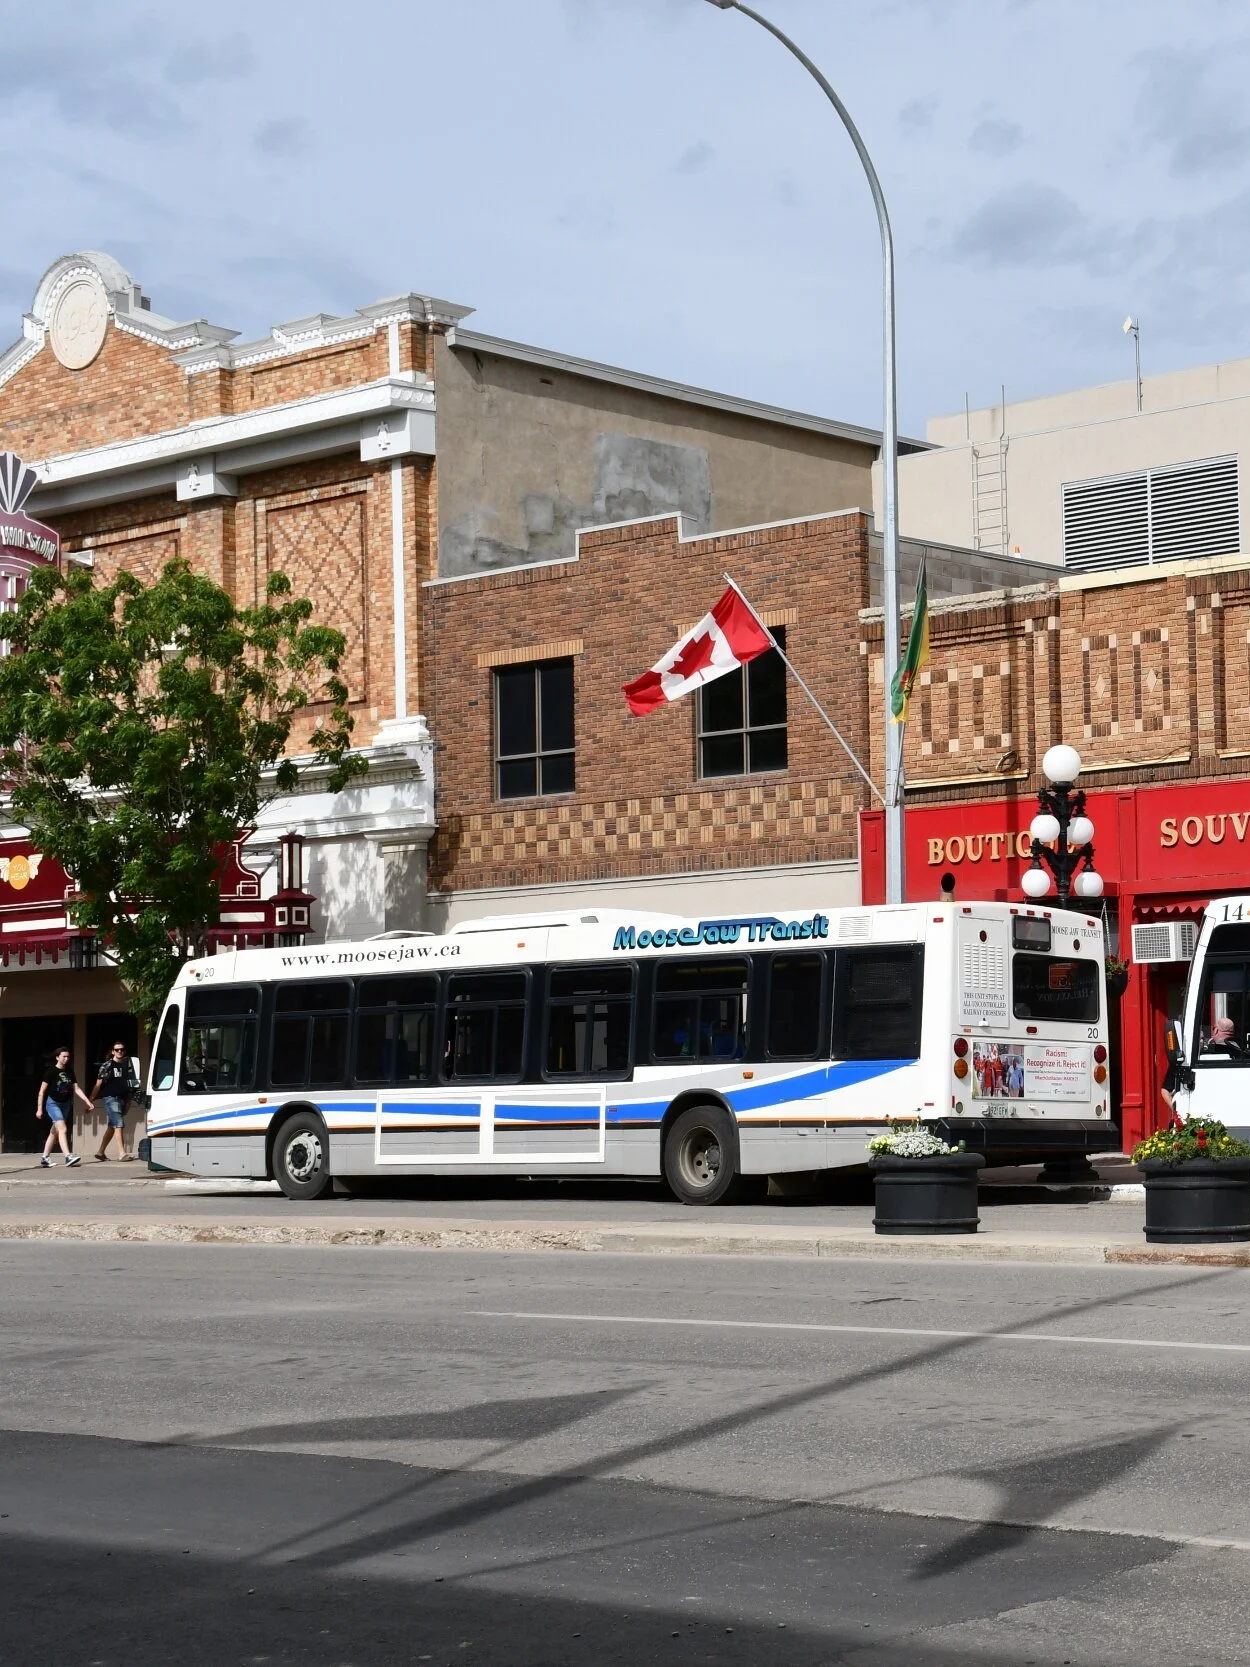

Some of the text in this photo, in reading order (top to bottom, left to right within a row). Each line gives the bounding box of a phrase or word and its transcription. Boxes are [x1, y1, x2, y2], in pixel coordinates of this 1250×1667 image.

[1222, 902, 1244, 922] 14
[1051, 925, 1067, 936] MOOSE
[1069, 927, 1080, 936] JAW
[1080, 928, 1102, 939] TRANSIT
[281, 945, 462, 967] www.moosejaw.ca
[204, 967, 215, 978] 20
[1087, 1027, 1099, 1039] 20
[1045, 1048, 1068, 1058] Racism:
[1026, 1058, 1056, 1069] Recognize
[1062, 1060, 1080, 1069] Reject
